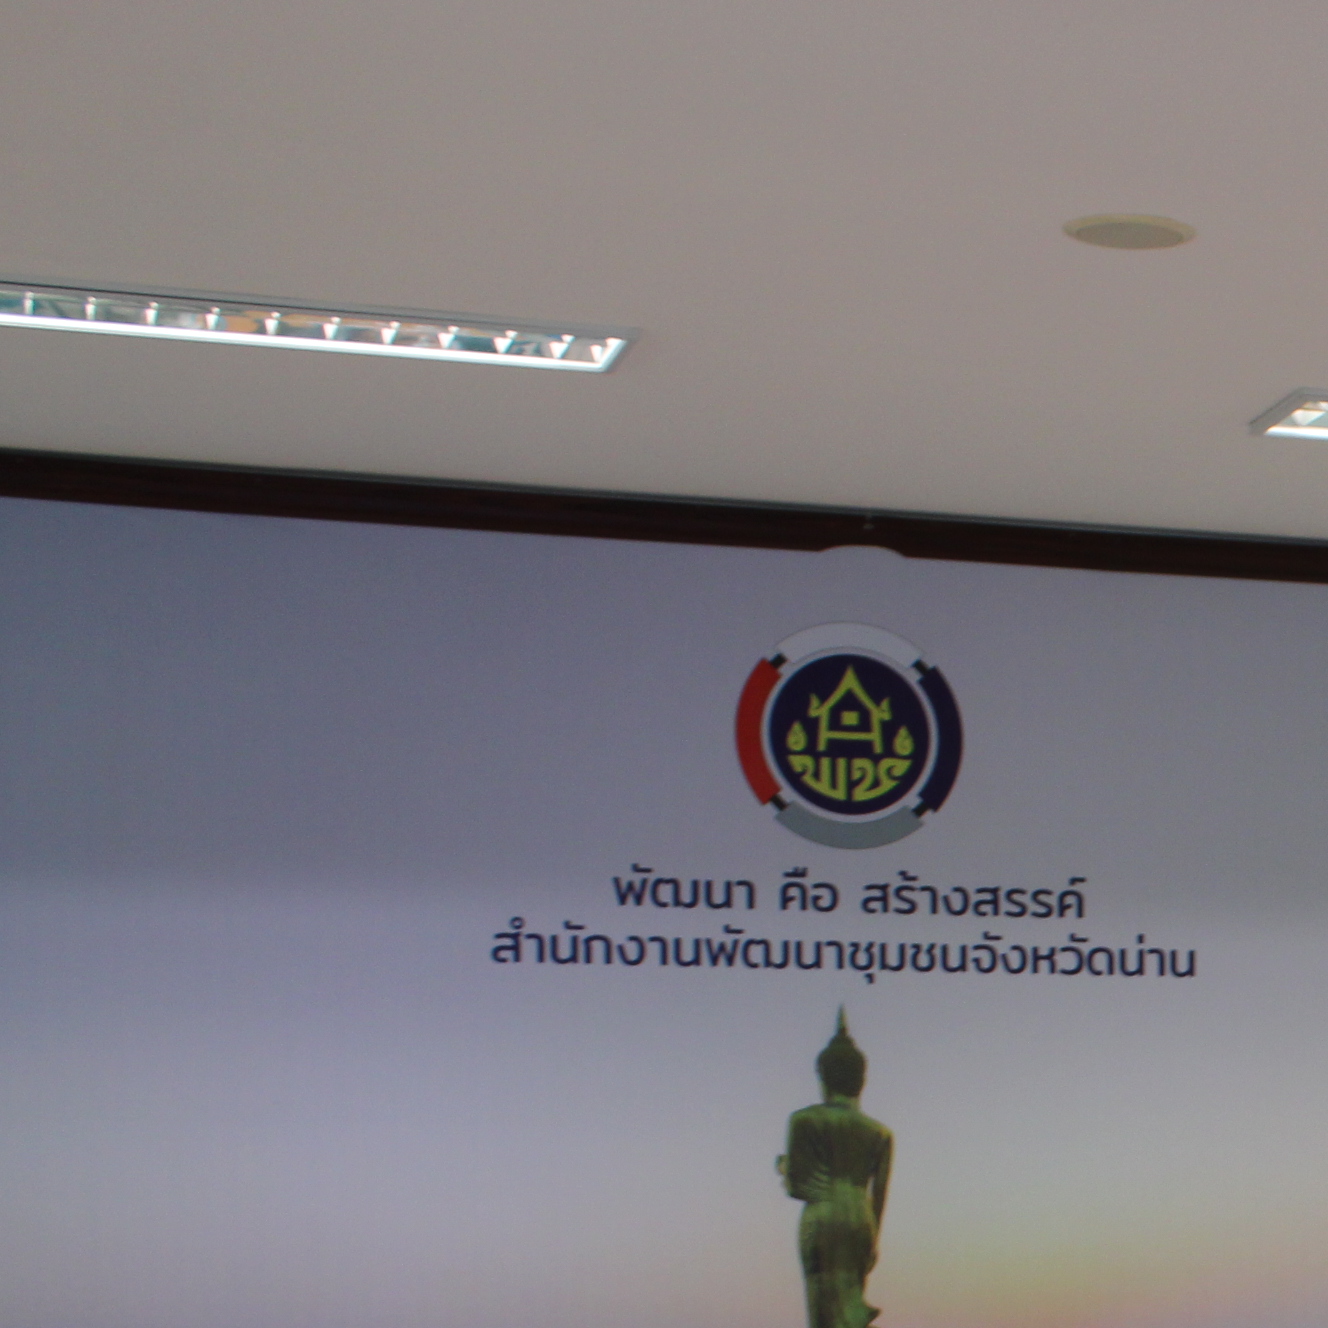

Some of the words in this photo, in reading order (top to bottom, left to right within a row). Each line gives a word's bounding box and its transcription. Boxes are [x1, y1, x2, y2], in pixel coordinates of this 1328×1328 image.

[612, 863, 756, 910] พัฒนา
[779, 866, 840, 913] คือ
[861, 870, 1088, 919] สร้างสรรค์
[490, 916, 1196, 985] สำนักงานพัฒนาชุมชนจังหวัดน่าน
